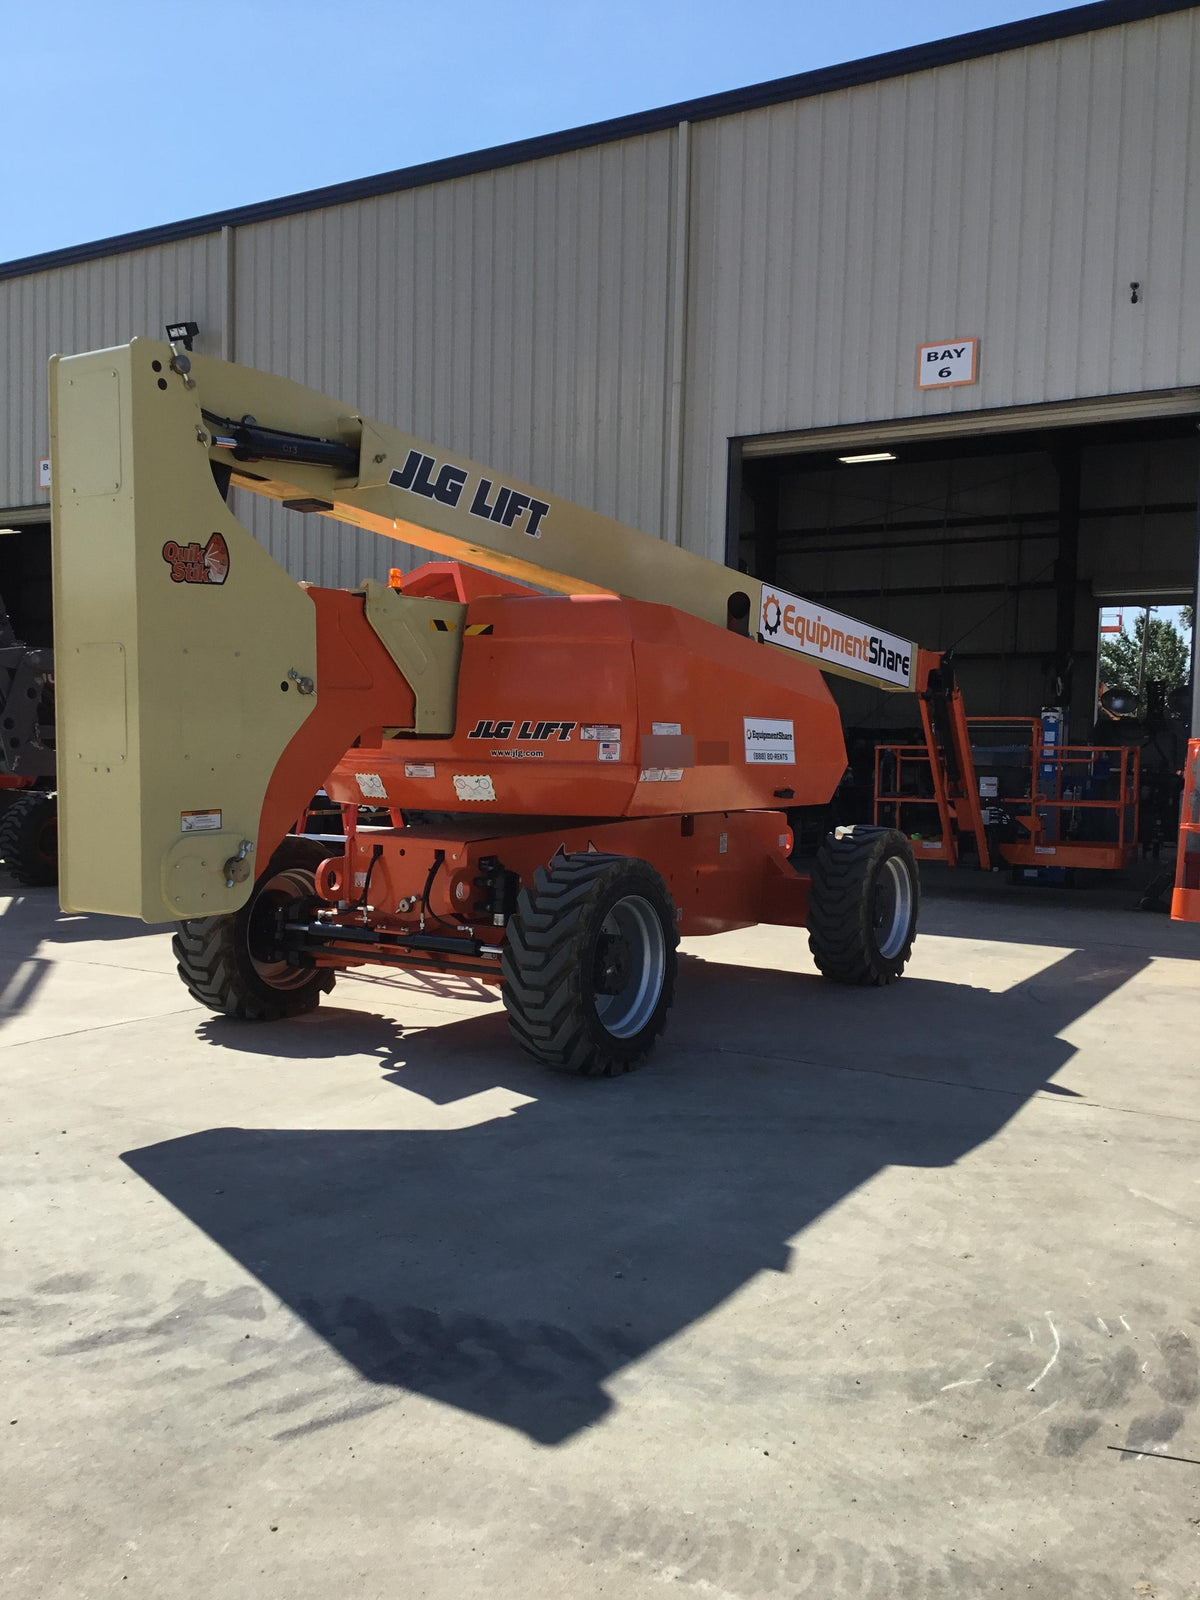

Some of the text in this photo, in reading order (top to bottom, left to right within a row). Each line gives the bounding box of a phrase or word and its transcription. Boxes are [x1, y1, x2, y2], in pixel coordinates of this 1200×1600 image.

[927, 347, 966, 362] BAY
[938, 366, 952, 378] 6
[388, 449, 551, 537] JLG LIFT
[163, 541, 206, 564] Quik
[171, 562, 209, 583] Stik
[783, 604, 909, 676] EquipmentShare
[468, 720, 515, 740] JLG
[516, 720, 577, 741] LIFT
[752, 730, 792, 741] EquipmentShare
[490, 749, 544, 759] www.jlg.com
